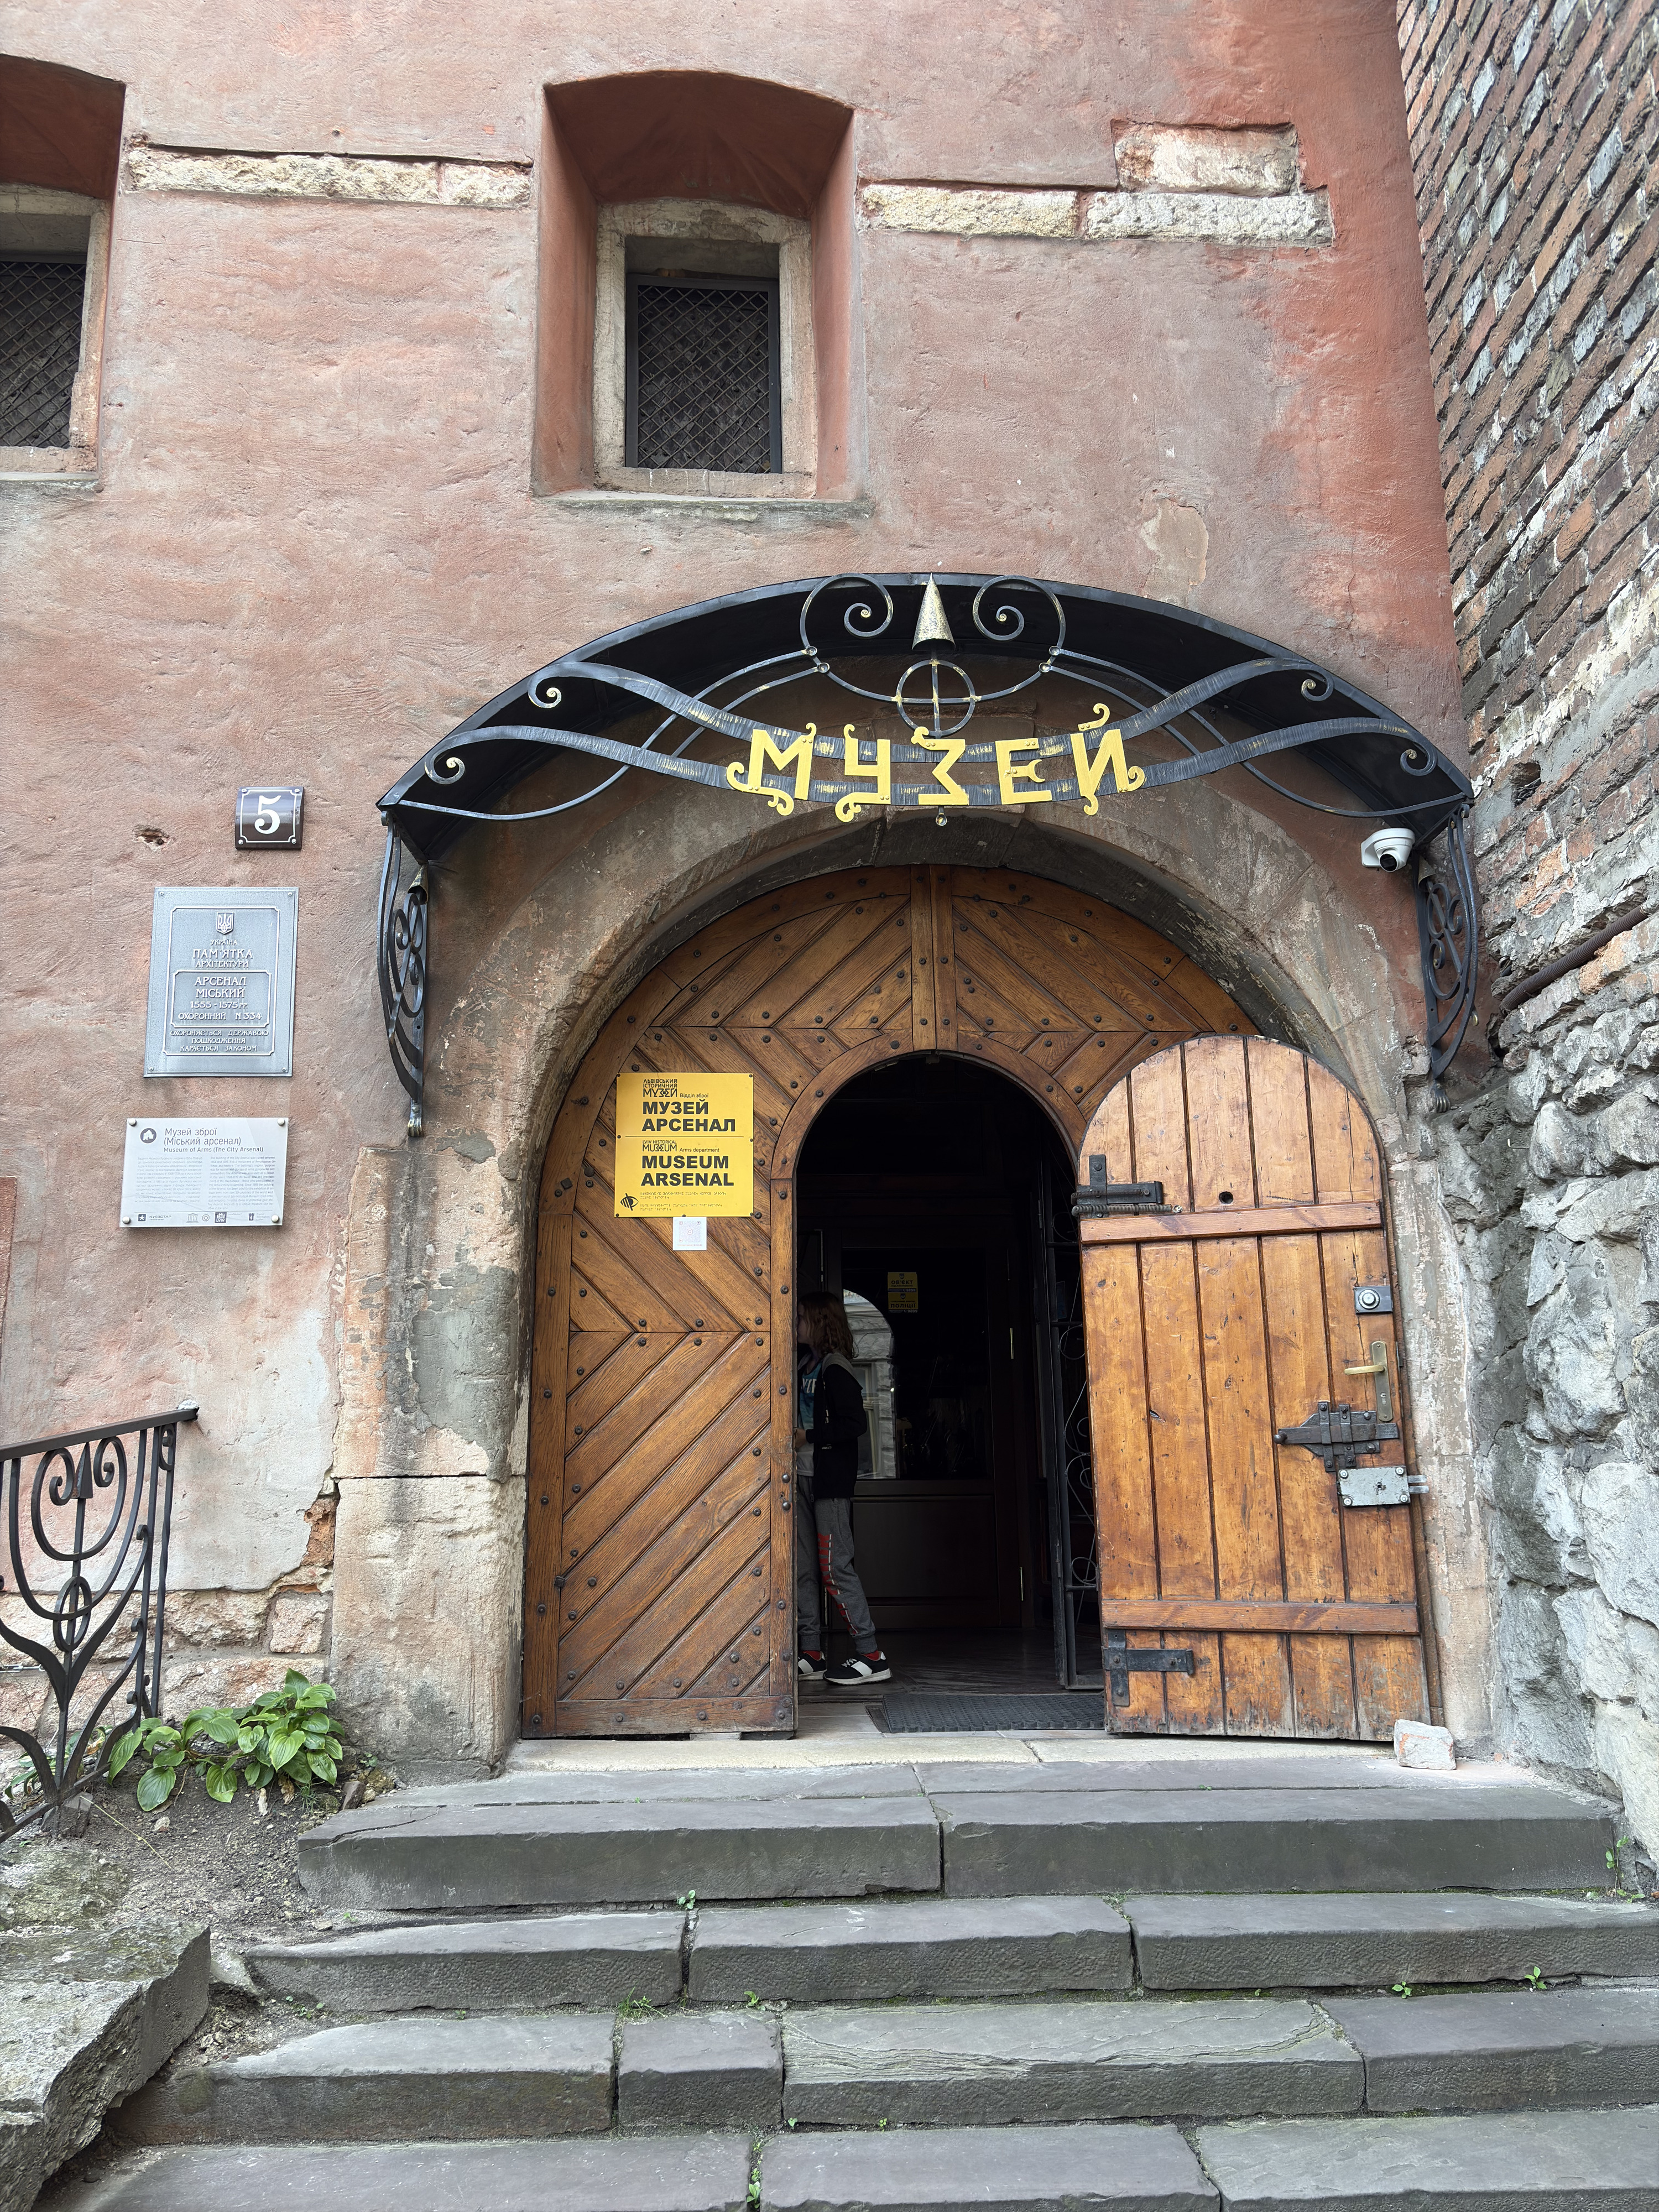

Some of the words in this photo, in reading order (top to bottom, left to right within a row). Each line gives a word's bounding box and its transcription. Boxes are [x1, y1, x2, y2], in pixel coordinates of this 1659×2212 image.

[726, 703, 1146, 822] МУЗЕЙ
[254, 795, 281, 834] 5
[194, 977, 247, 987] АРСЕНАЛ
[195, 988, 245, 998] МІСЬКИЙ
[643, 1099, 708, 1114] МУЗЕЙ
[641, 1118, 735, 1131] АРСЕНАЛ
[165, 1128, 192, 1136] Музей
[195, 1128, 217, 1137] зброї
[164, 1136, 201, 1146] (Міський
[204, 1137, 241, 1146] арсенал)
[642, 1155, 729, 1168] MUSEUM
[641, 1173, 734, 1186] ARSENAL
